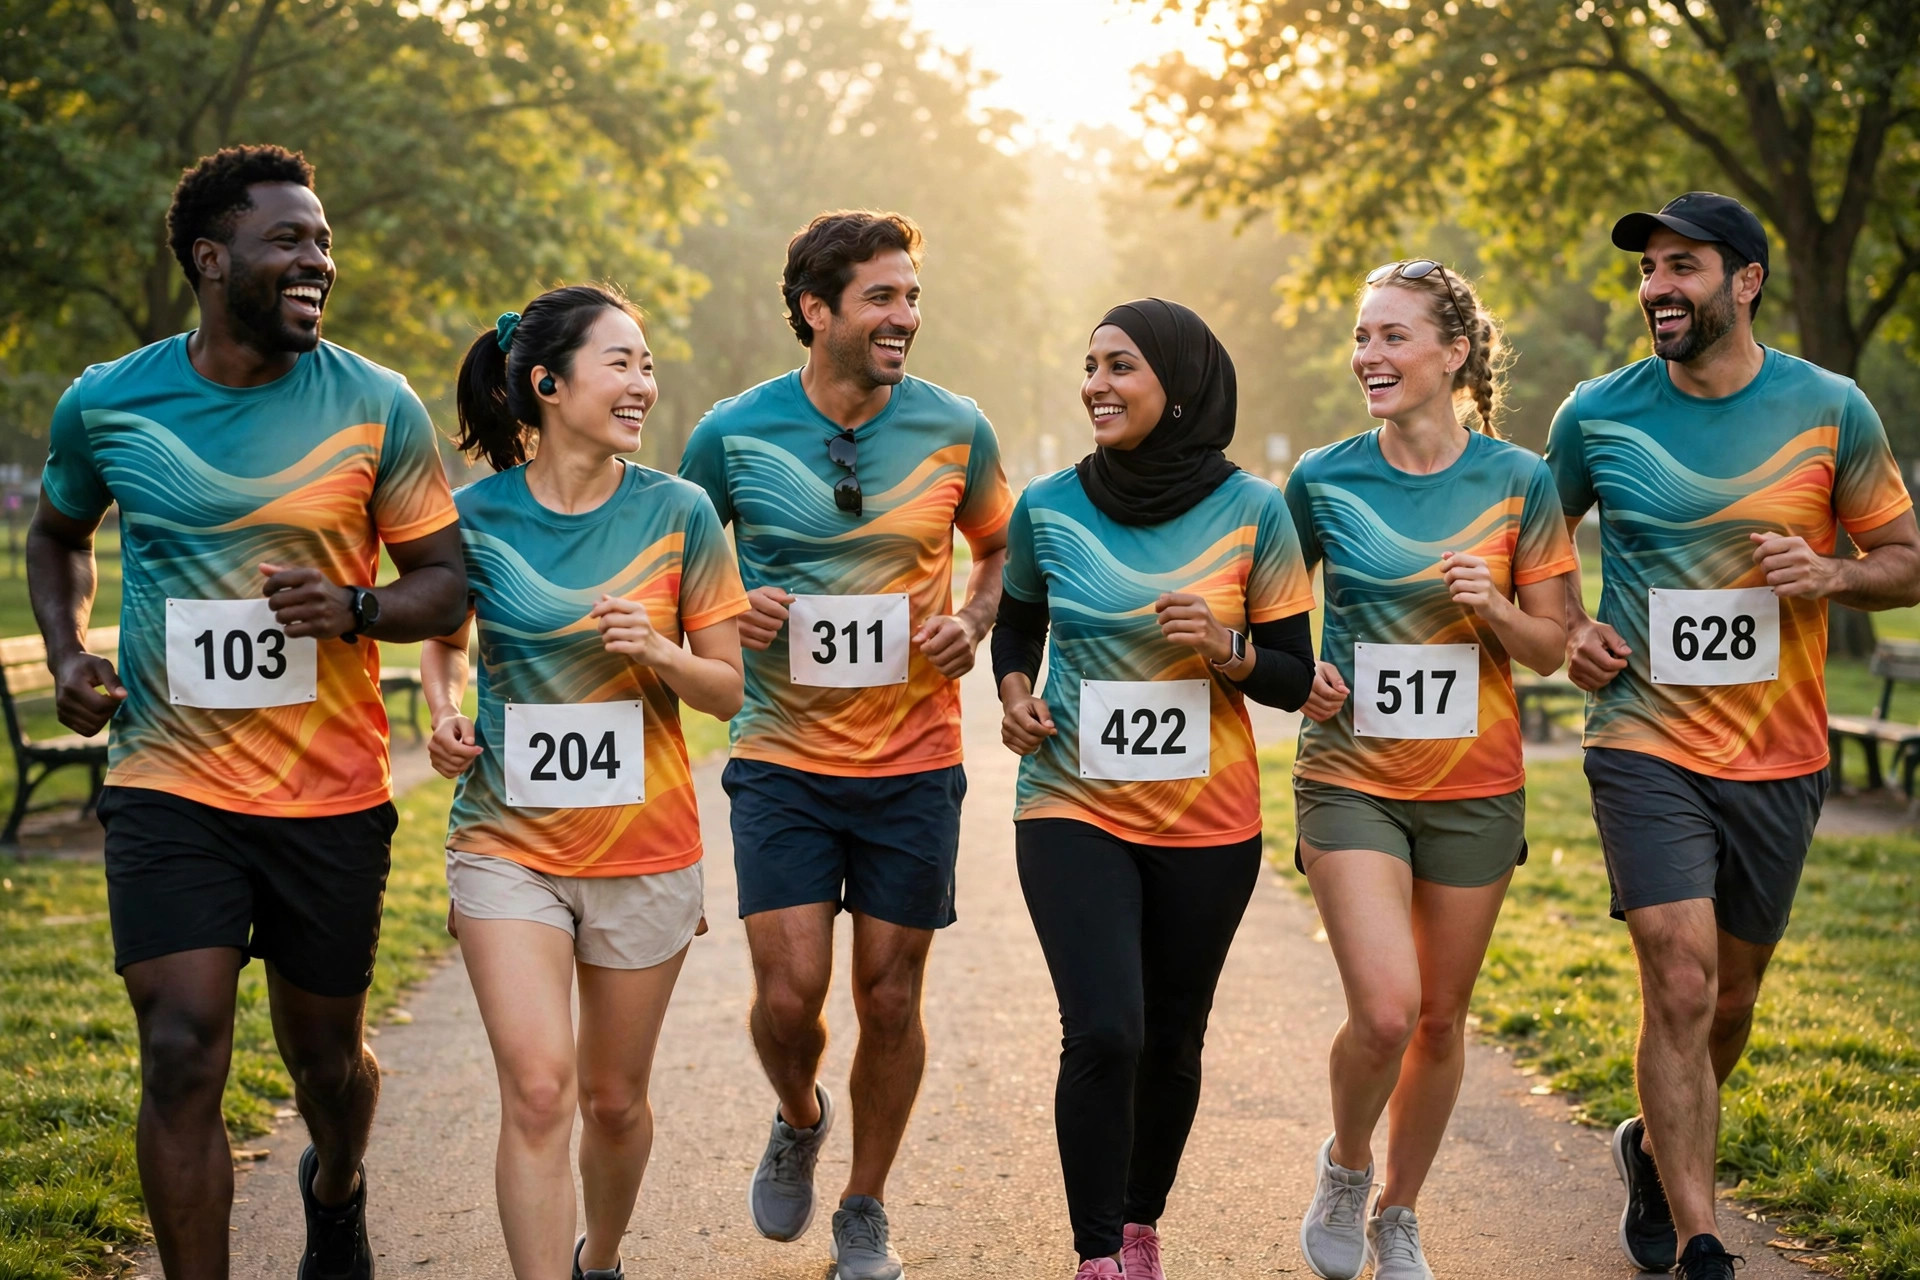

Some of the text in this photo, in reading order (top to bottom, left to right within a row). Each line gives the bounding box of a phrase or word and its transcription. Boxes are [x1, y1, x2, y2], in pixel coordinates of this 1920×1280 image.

[194, 629, 287, 680] 103
[811, 620, 883, 664] 311
[1673, 615, 1757, 661] 628
[1376, 670, 1457, 714] 517
[1101, 708, 1187, 755] 422
[529, 731, 621, 781] 204
